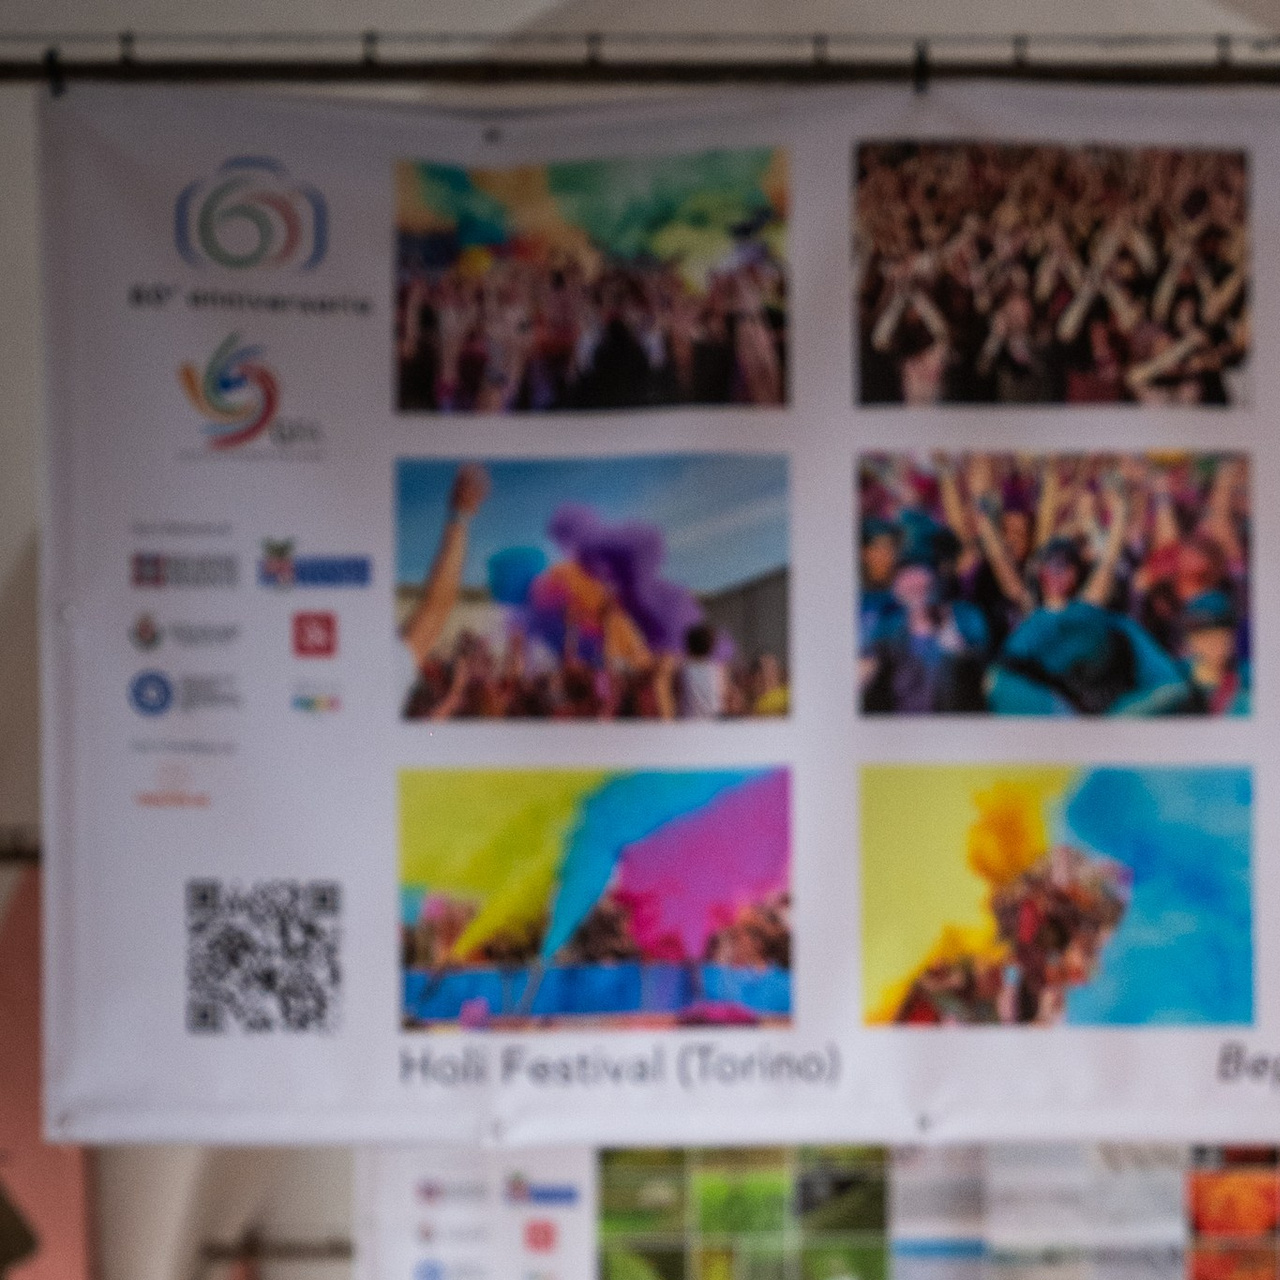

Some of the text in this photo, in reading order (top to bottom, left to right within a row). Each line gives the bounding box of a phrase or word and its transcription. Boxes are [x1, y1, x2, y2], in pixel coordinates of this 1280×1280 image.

[401, 1039, 842, 1090] Holi Festival (Torino)
